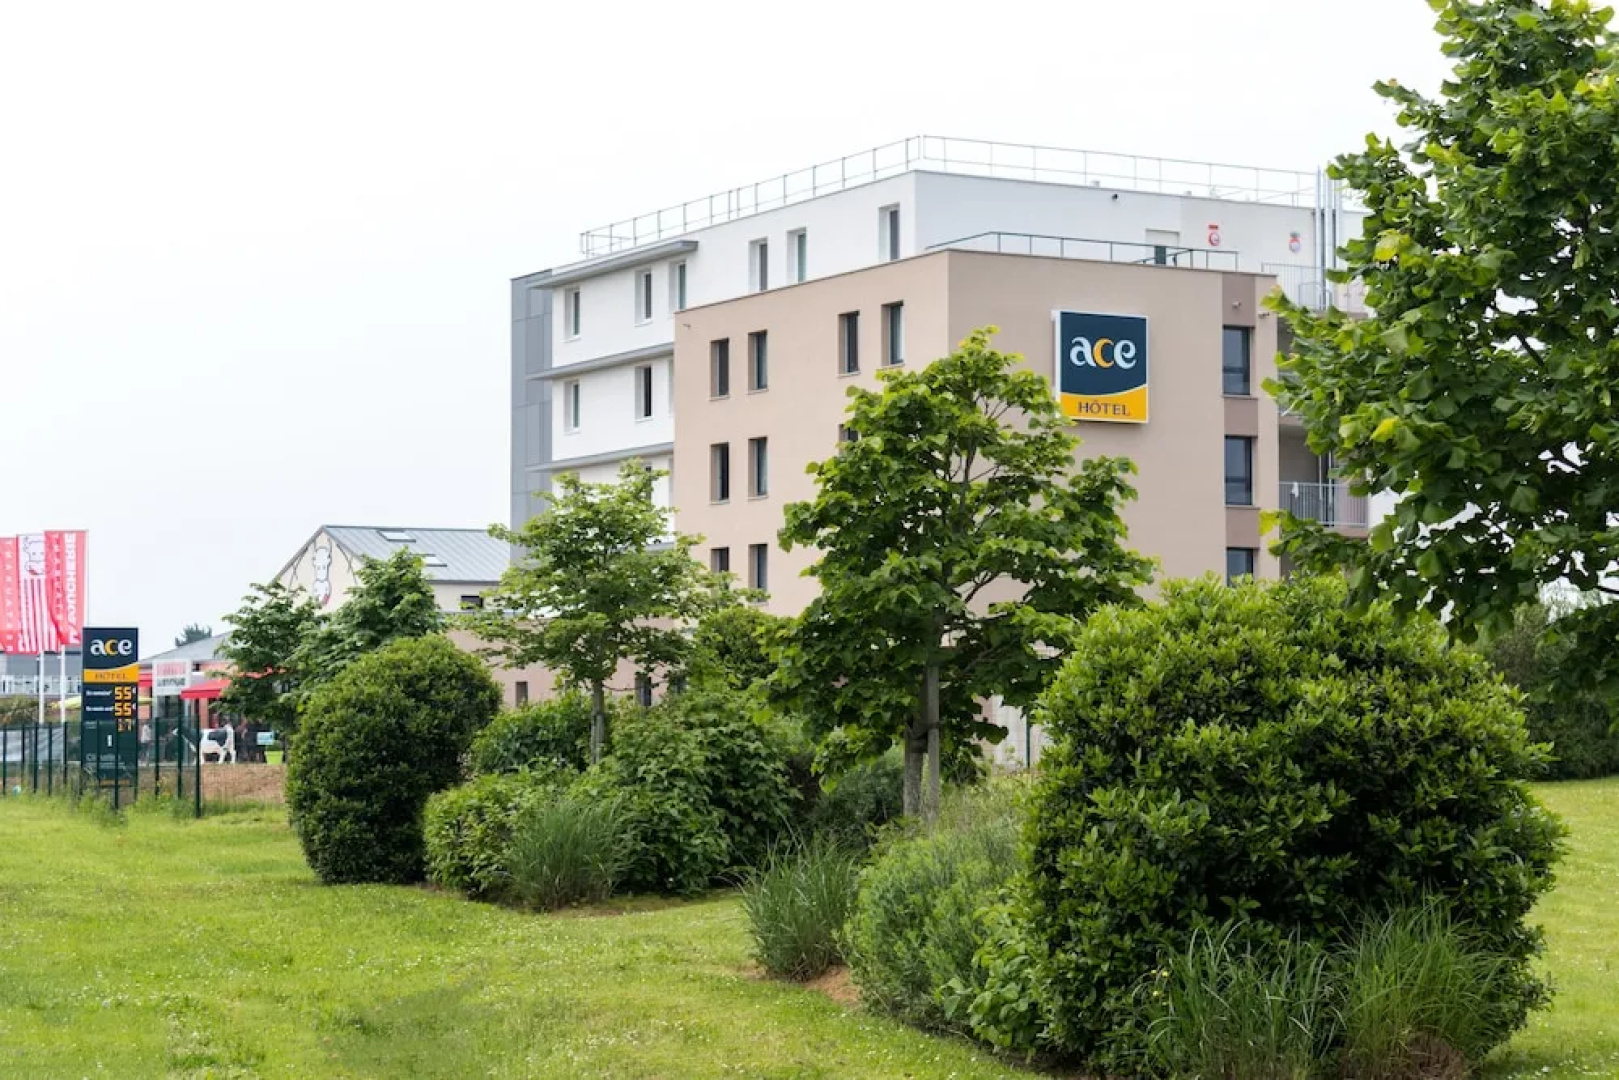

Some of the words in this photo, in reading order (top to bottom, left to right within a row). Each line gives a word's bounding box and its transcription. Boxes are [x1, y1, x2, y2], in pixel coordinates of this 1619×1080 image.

[1069, 336, 1137, 370] ace
[1078, 400, 1131, 416] HÔTEL
[90, 639, 132, 656] ace
[115, 686, 131, 700] 55
[115, 703, 131, 717] 55
